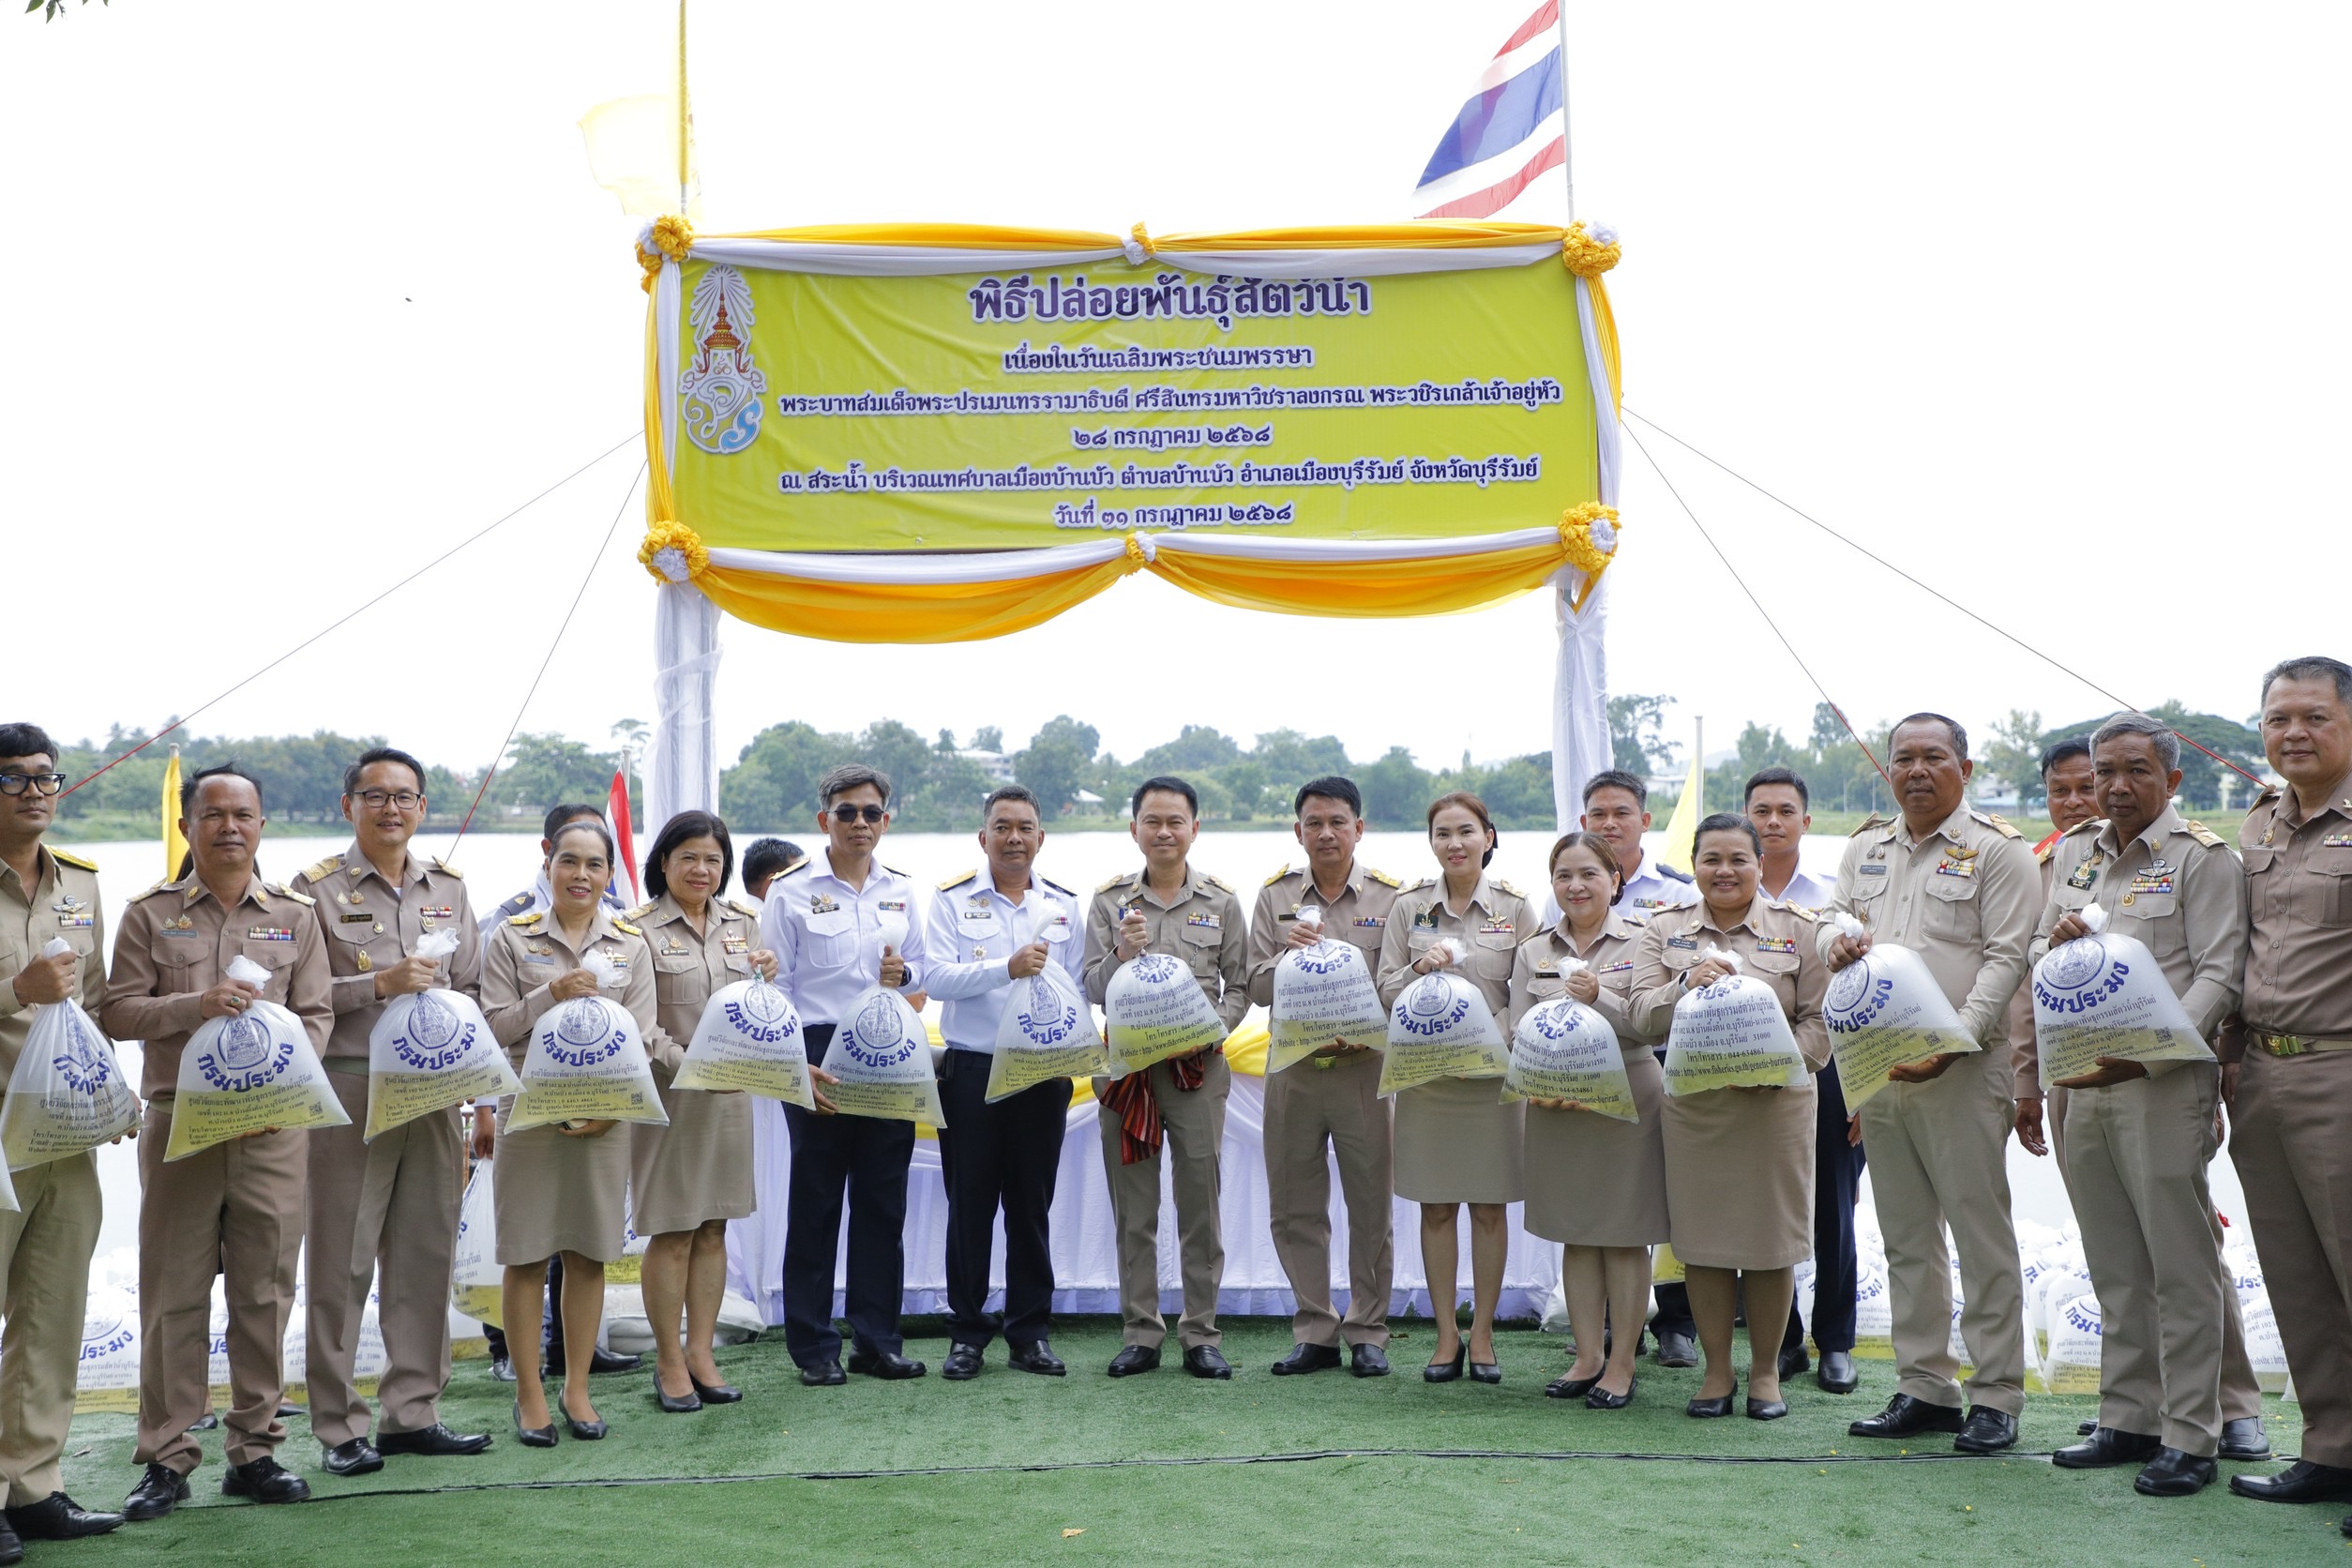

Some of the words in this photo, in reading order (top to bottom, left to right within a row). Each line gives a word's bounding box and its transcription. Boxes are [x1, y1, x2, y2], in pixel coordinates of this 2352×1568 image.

[1004, 341, 1312, 369] เนื่องในวันเฉลิมพระชนมพรรษา
[780, 387, 1128, 413] พระบาทสมเด็จพระปรเมนทรรามาธิบดี
[1135, 385, 1365, 408] ศรีสินทรมหาวิชราลงกรณ
[1369, 380, 1560, 408] พระวชิรเกล้าเจ้าอยู่หัว
[1074, 429, 1108, 445] ๒๘
[1113, 429, 1201, 448] กรกฎาคม
[1206, 425, 1271, 444] ๒๕๖๘
[780, 475, 803, 493] ณ
[807, 462, 867, 490] สระน้ำ
[872, 465, 1114, 489] บริเวณเทศบาลเมืองบ้านบัว
[1121, 463, 1234, 486] ตำบลบ้านบัว
[1240, 458, 1405, 487] อำเภอเมืองบุรีรัมย์
[1410, 457, 1539, 485] จังหวัดบุรีรัมย์
[1055, 499, 1094, 524] วันที่
[1135, 507, 1222, 527] กรกฎาคม
[1228, 504, 1292, 521] ๒๕๖๘
[2033, 960, 2130, 1013] กรมประมง
[1395, 998, 1470, 1036] กรมประมง
[392, 1022, 476, 1070] กรมประมง
[542, 1030, 626, 1066] กรมประมง
[842, 1029, 916, 1068] กรมประมง
[197, 1042, 294, 1093] กรมประมง
